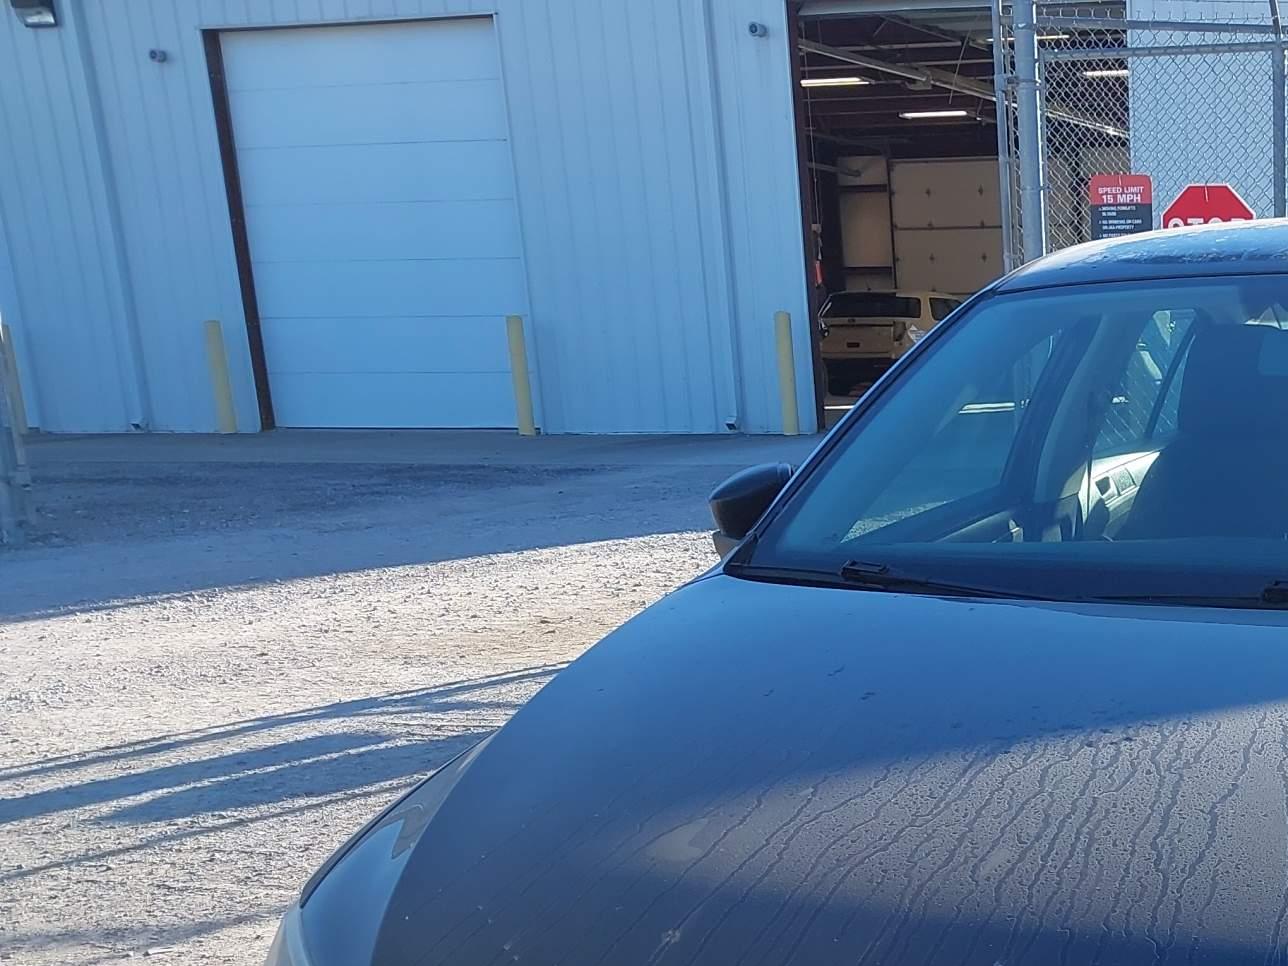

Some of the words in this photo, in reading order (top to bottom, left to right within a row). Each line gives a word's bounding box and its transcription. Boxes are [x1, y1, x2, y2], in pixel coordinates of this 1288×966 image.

[1124, 186, 1144, 194] LIMIT
[1102, 195, 1113, 203] 15
[1117, 194, 1141, 203] MPH
